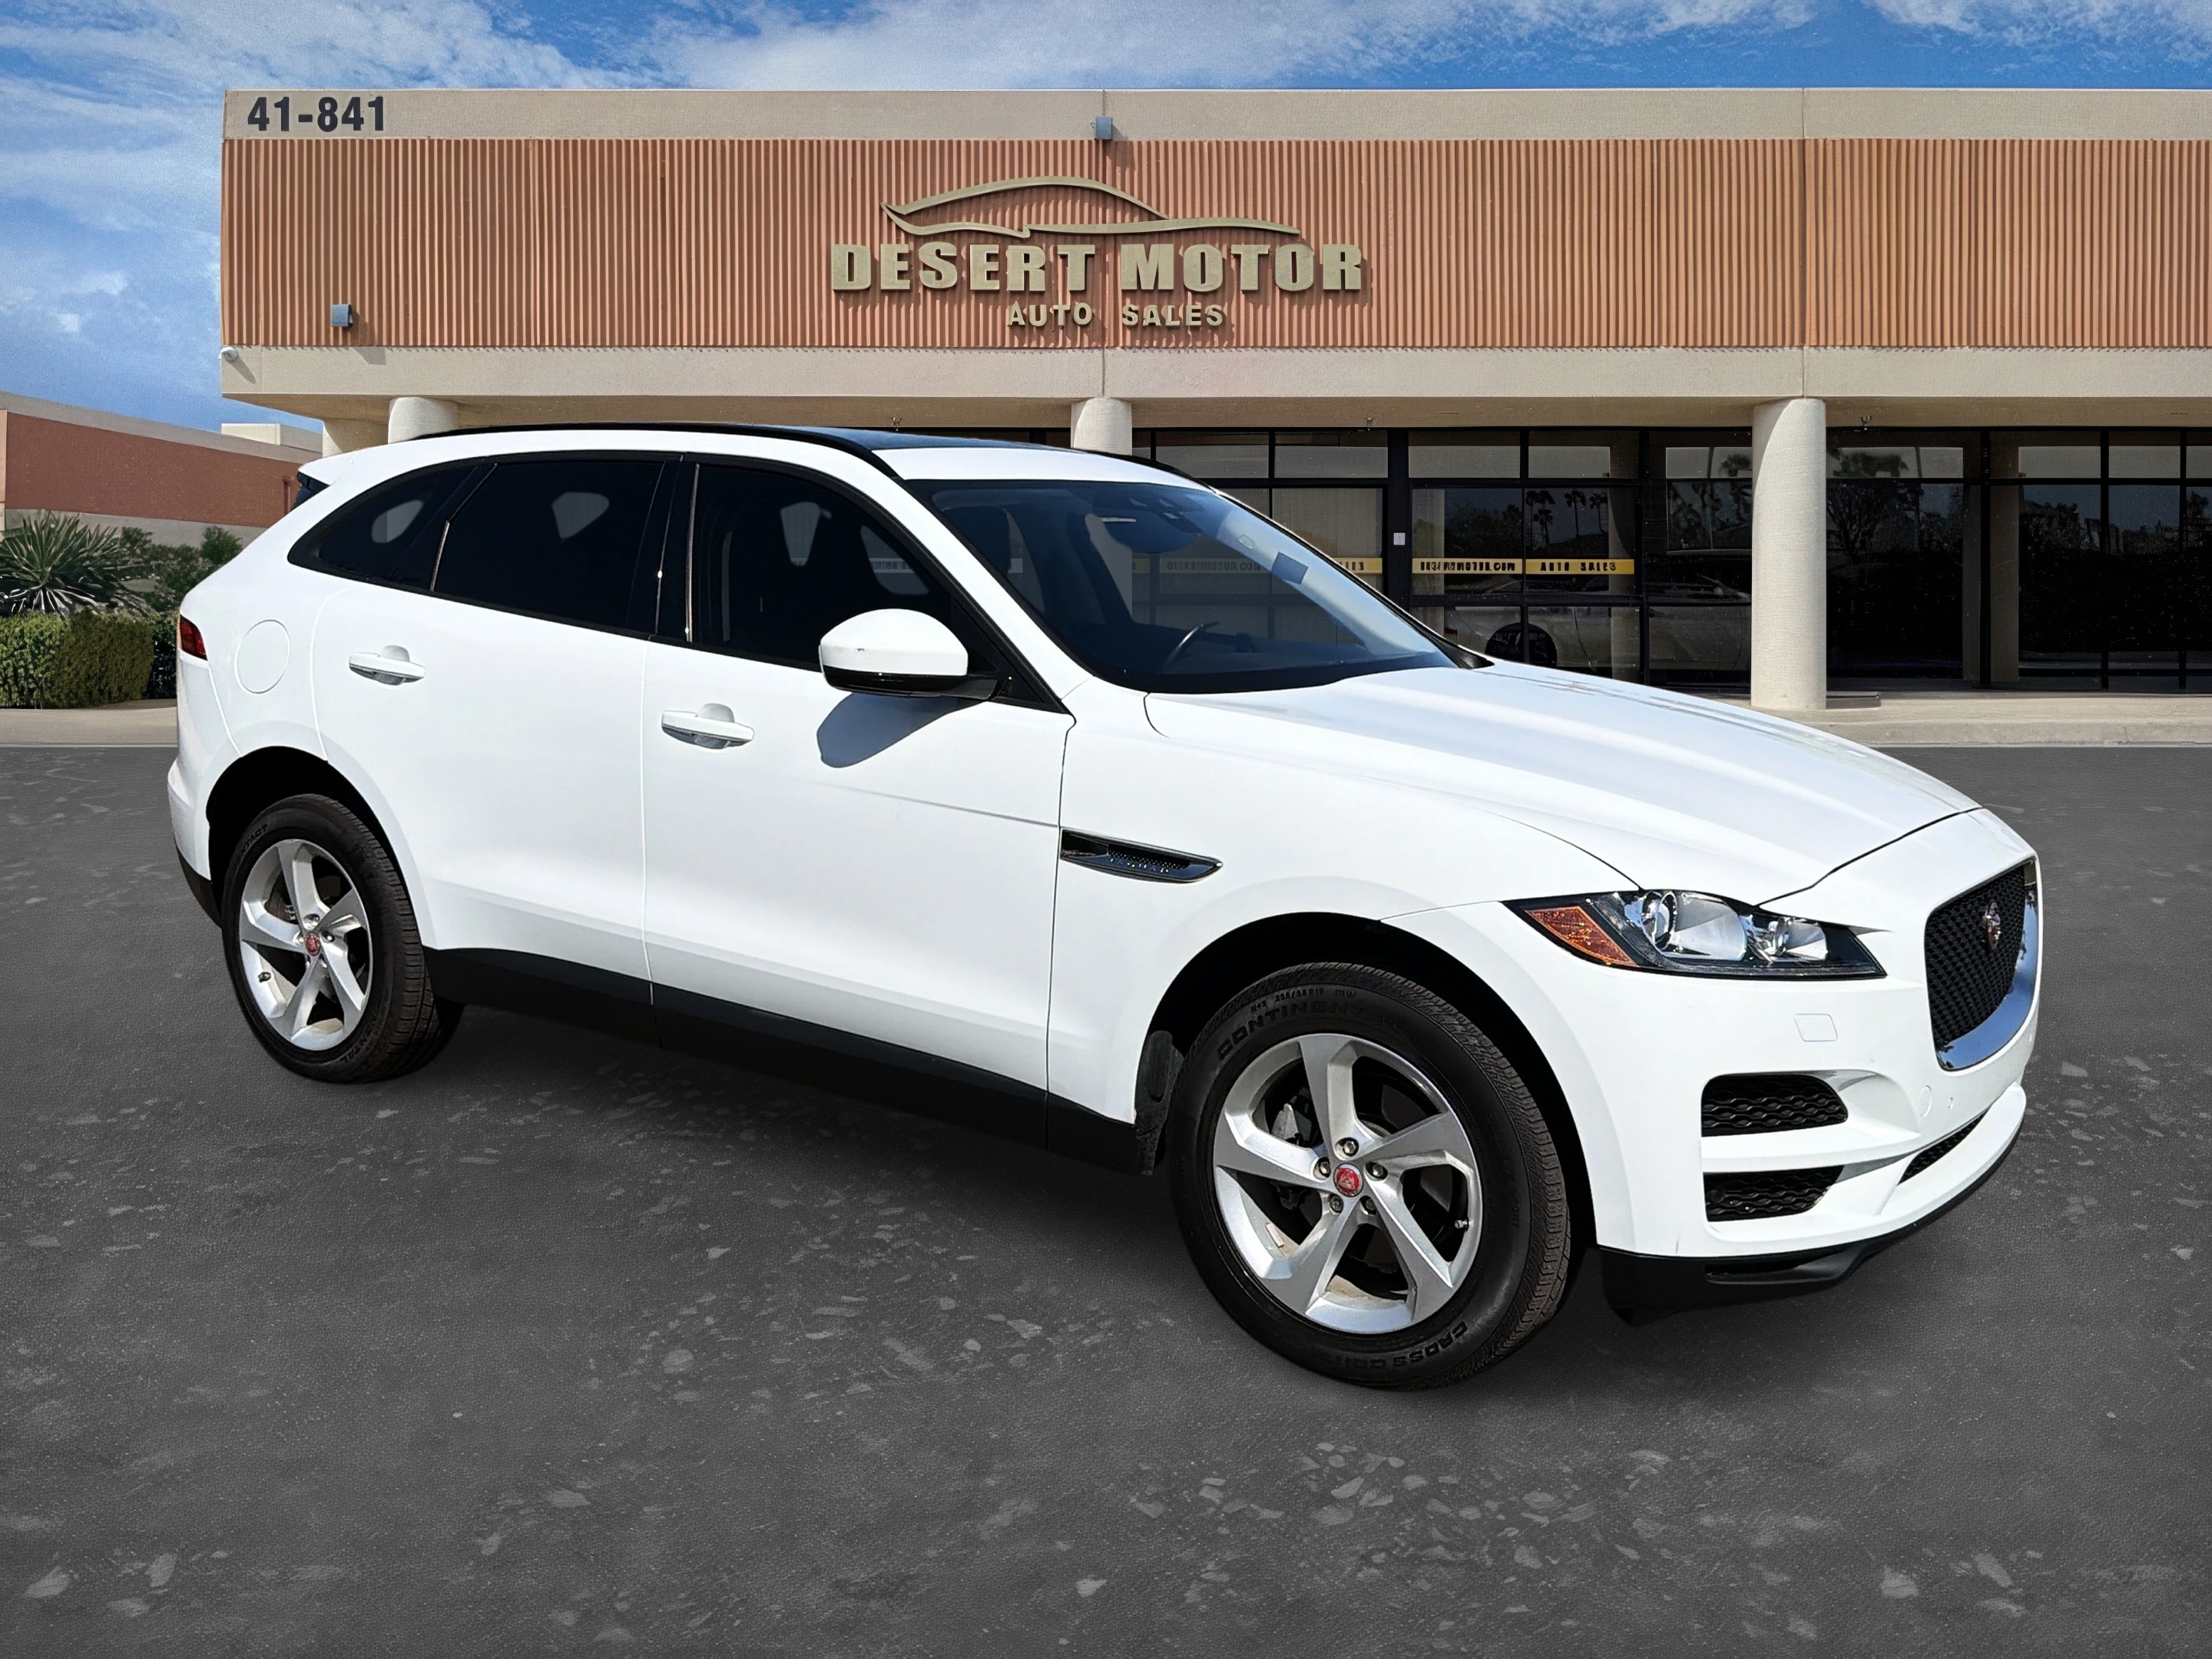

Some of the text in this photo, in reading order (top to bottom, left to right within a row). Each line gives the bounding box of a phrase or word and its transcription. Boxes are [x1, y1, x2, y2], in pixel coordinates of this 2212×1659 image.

[247, 96, 384, 132] 41-841
[831, 241, 1363, 292] DESERT MOTOR
[1008, 300, 1224, 326] AUTO SALES
